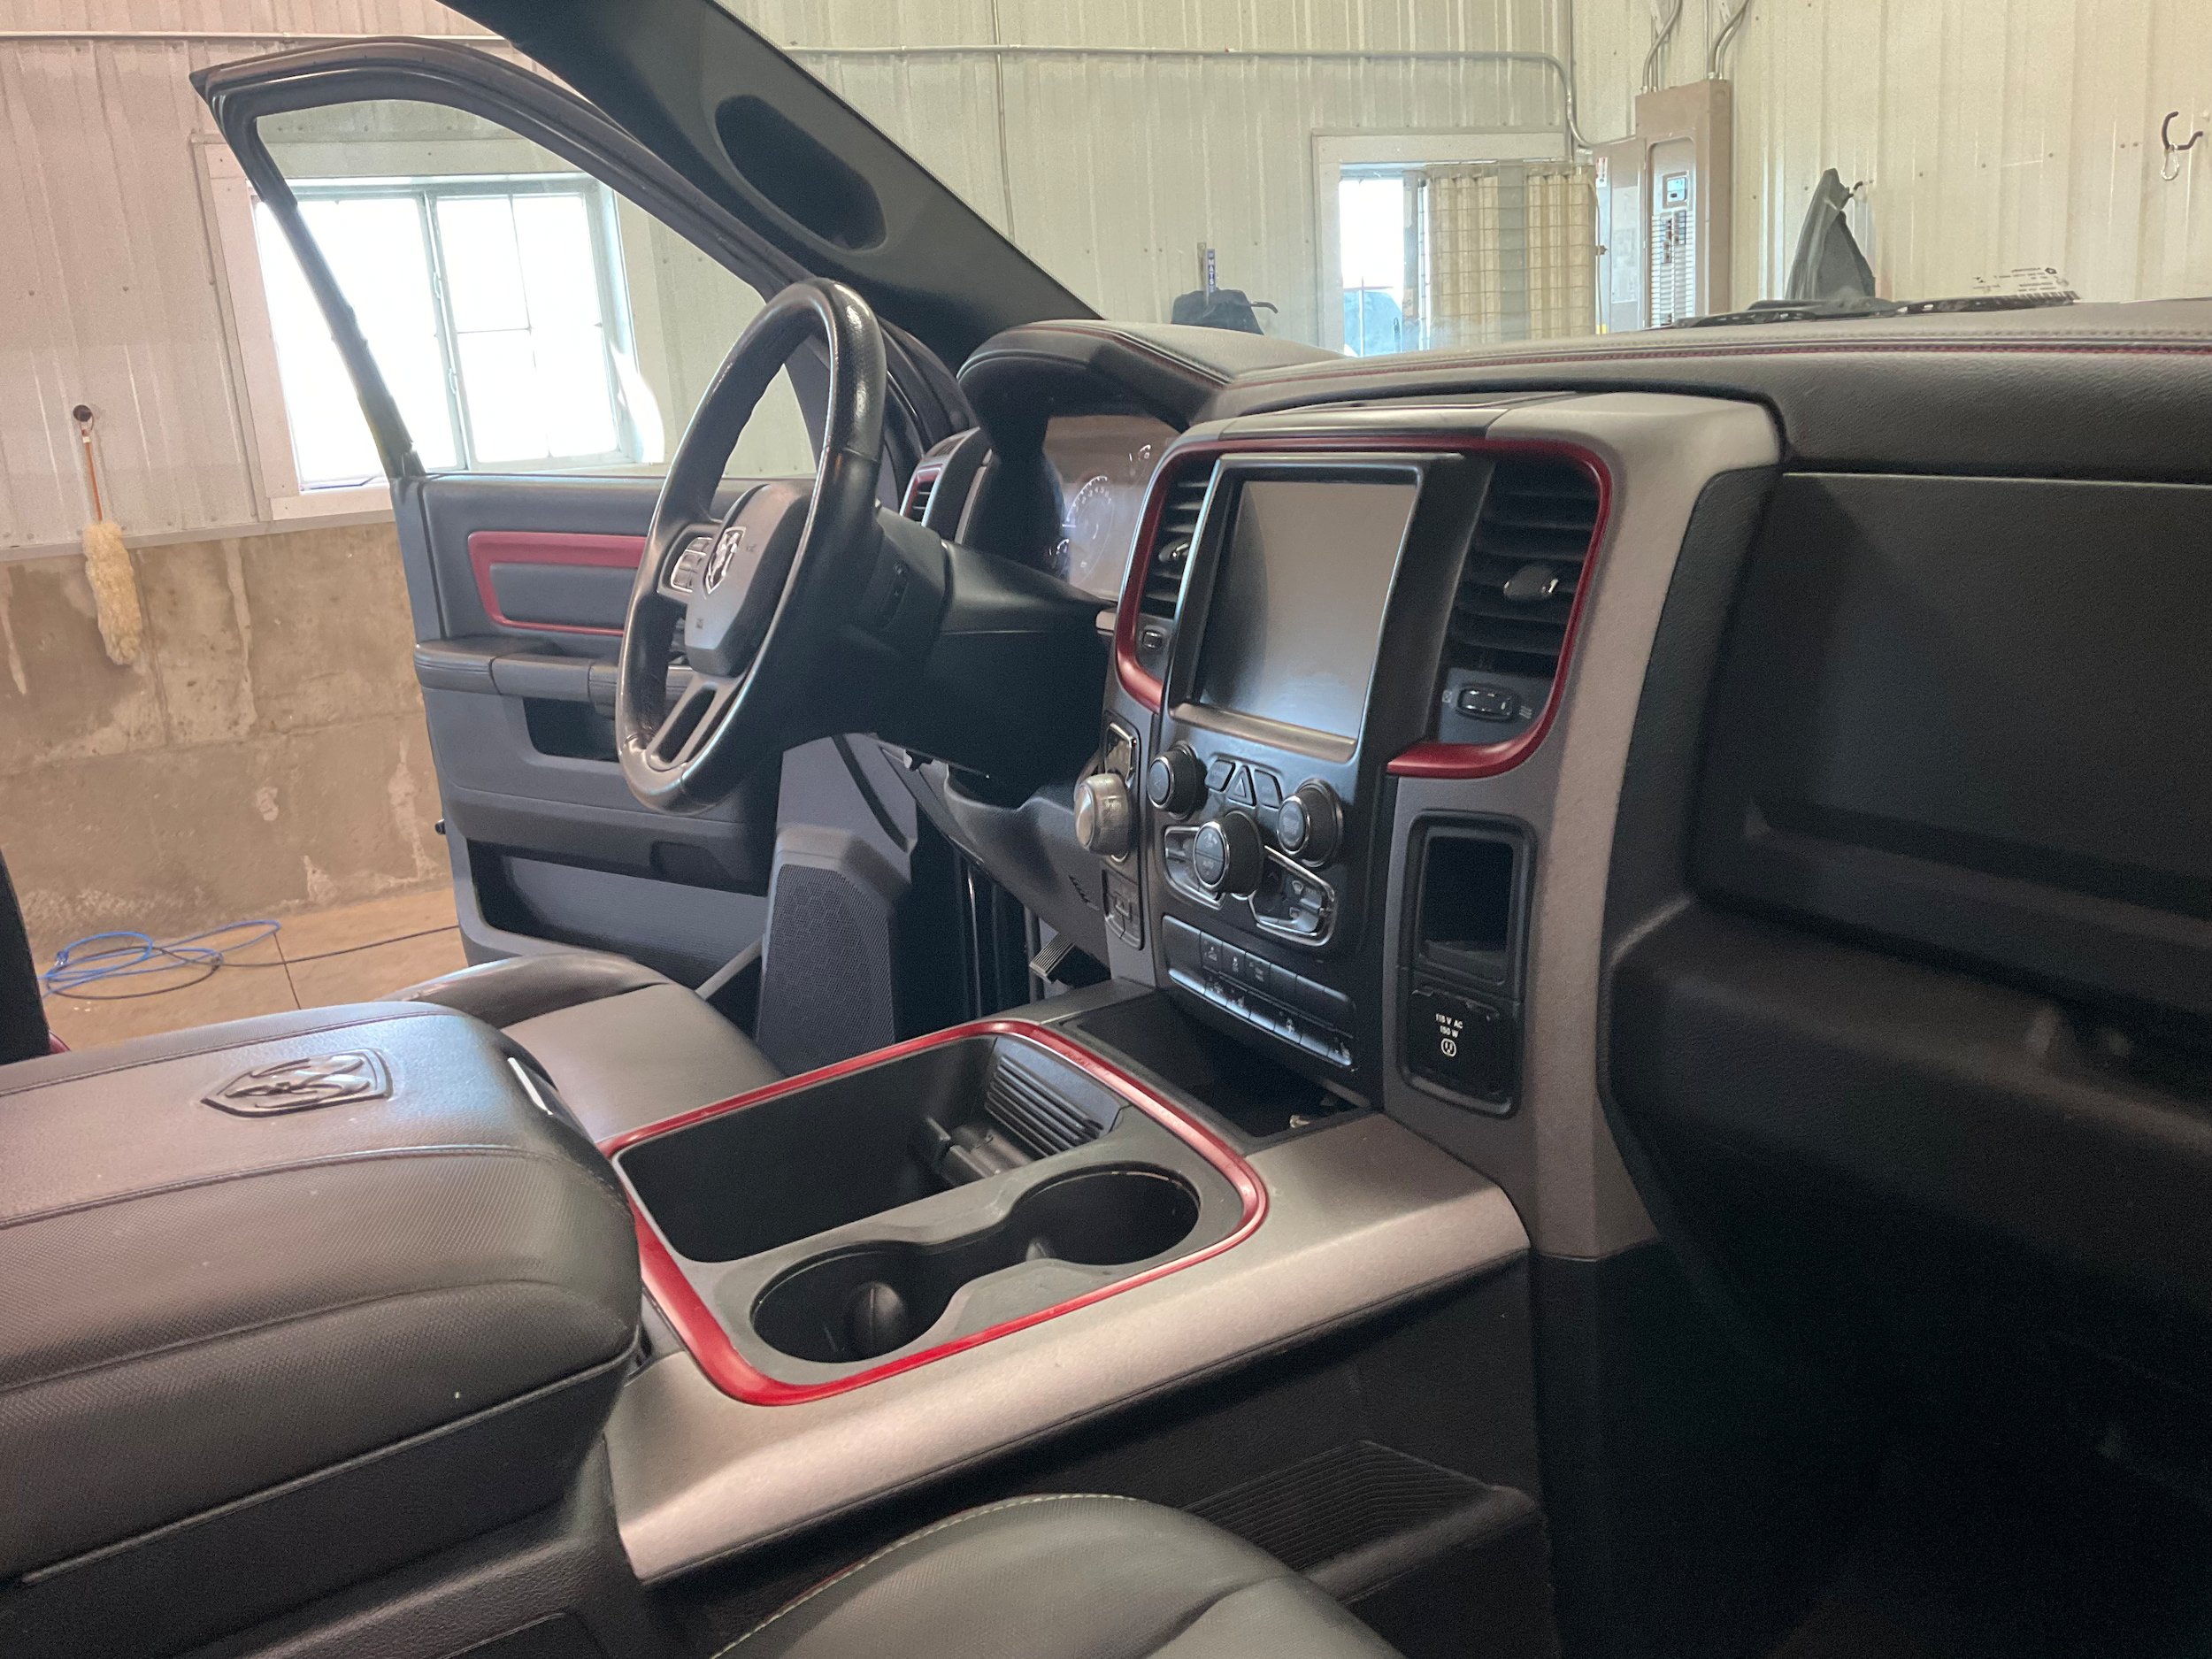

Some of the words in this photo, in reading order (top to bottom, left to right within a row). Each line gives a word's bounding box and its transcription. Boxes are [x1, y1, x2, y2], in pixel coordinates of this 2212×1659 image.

[1435, 1013, 1446, 1024] 115
[1446, 1016, 1452, 1025] V
[1453, 1019, 1463, 1029] AC
[1440, 1025, 1451, 1036] 150
[1451, 1029, 1459, 1038] W
